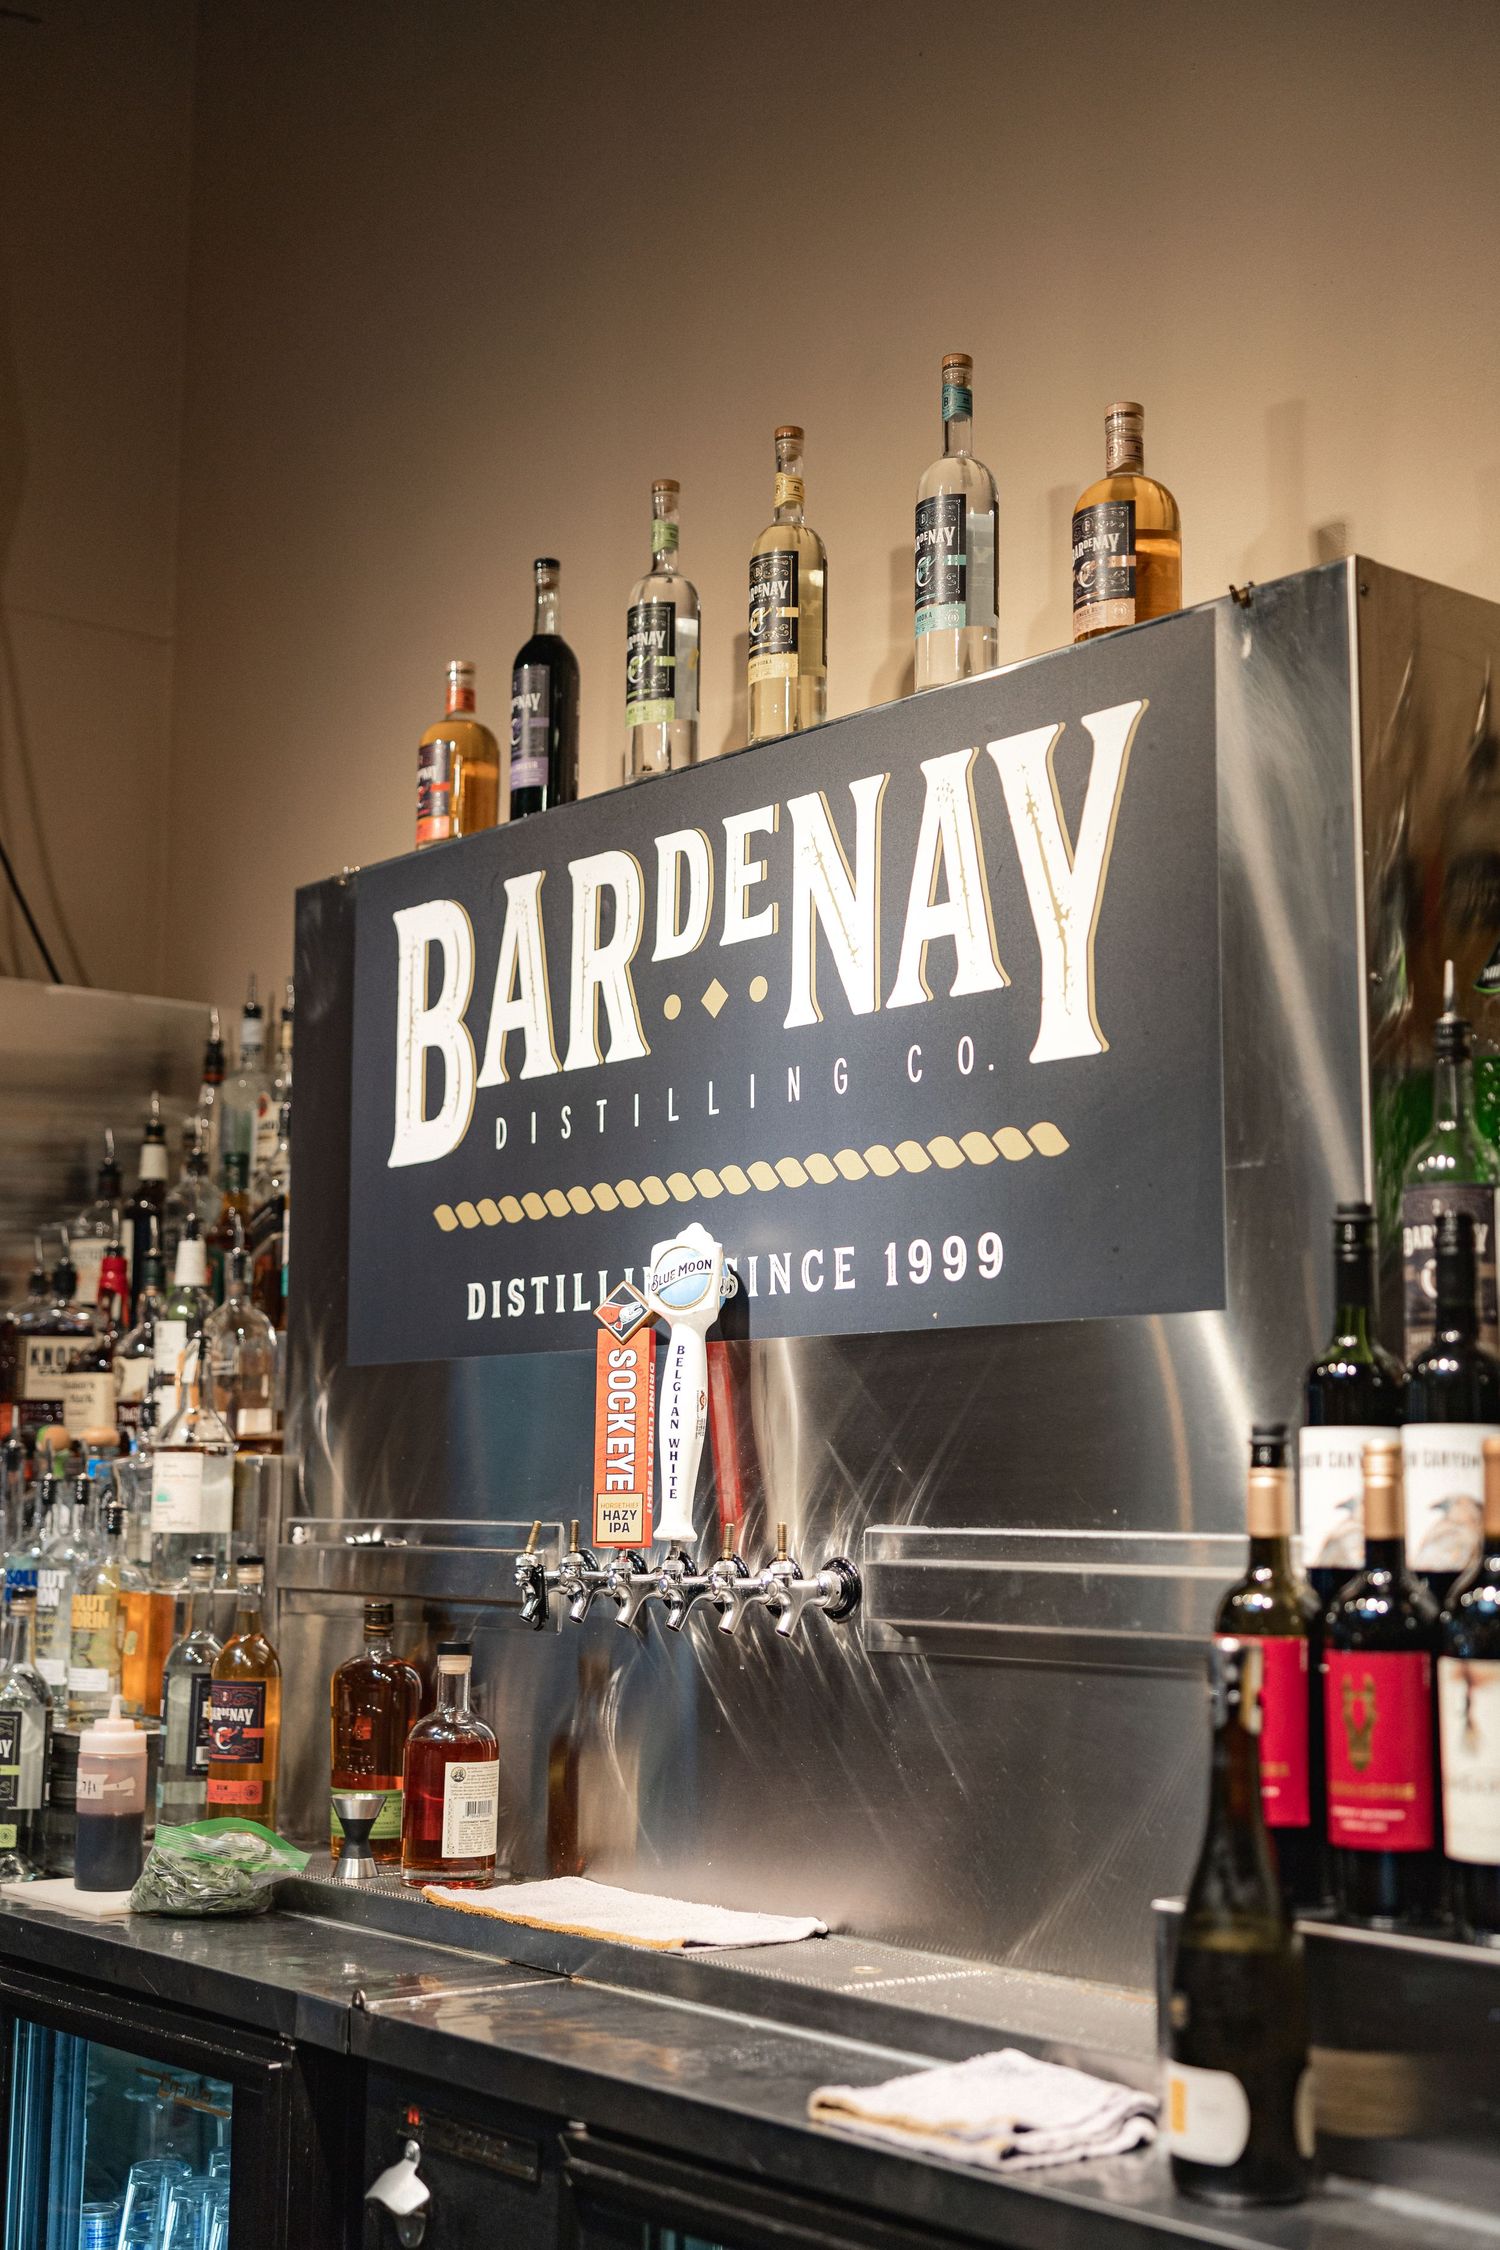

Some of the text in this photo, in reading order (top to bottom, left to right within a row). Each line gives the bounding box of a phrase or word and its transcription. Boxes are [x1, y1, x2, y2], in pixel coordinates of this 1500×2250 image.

[387, 698, 1149, 1169] BARDENAY
[495, 1035, 995, 1151] DISTILLING CO.
[467, 1267, 651, 1321] DISTILLI
[884, 1231, 1004, 1287] 1999
[651, 1259, 713, 1292] BLUE MOON
[606, 1347, 637, 1491] SOCKEYE
[668, 1345, 685, 1499] BELGIAN WHITE
[603, 1510, 637, 1520] HAZY
[609, 1522, 630, 1533] IPA
